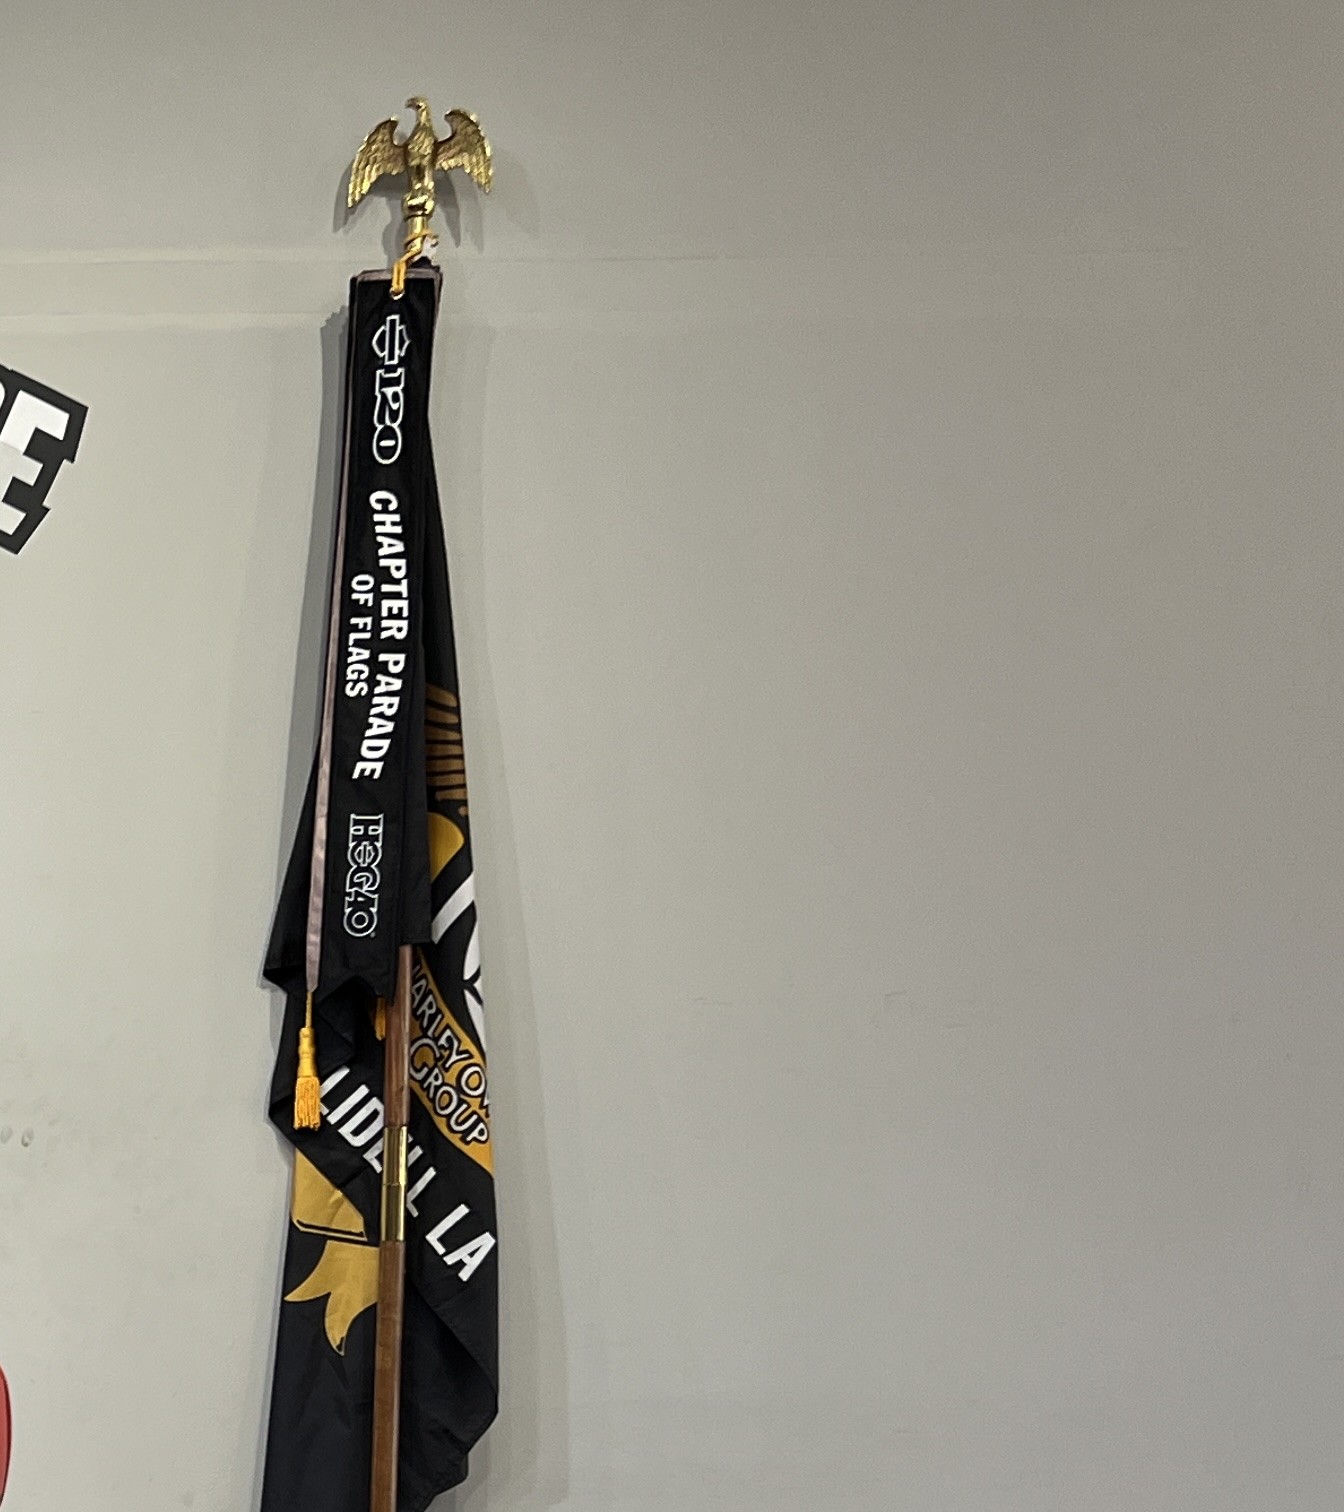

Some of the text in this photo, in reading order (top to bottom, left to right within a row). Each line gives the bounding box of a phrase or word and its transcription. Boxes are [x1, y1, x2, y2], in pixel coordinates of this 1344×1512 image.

[344, 573, 375, 699] OF FLAGS
[351, 489, 409, 780] CHAPTER PARADE
[408, 1037, 489, 1143] GROUP
[424, 1203, 496, 1282] LA
